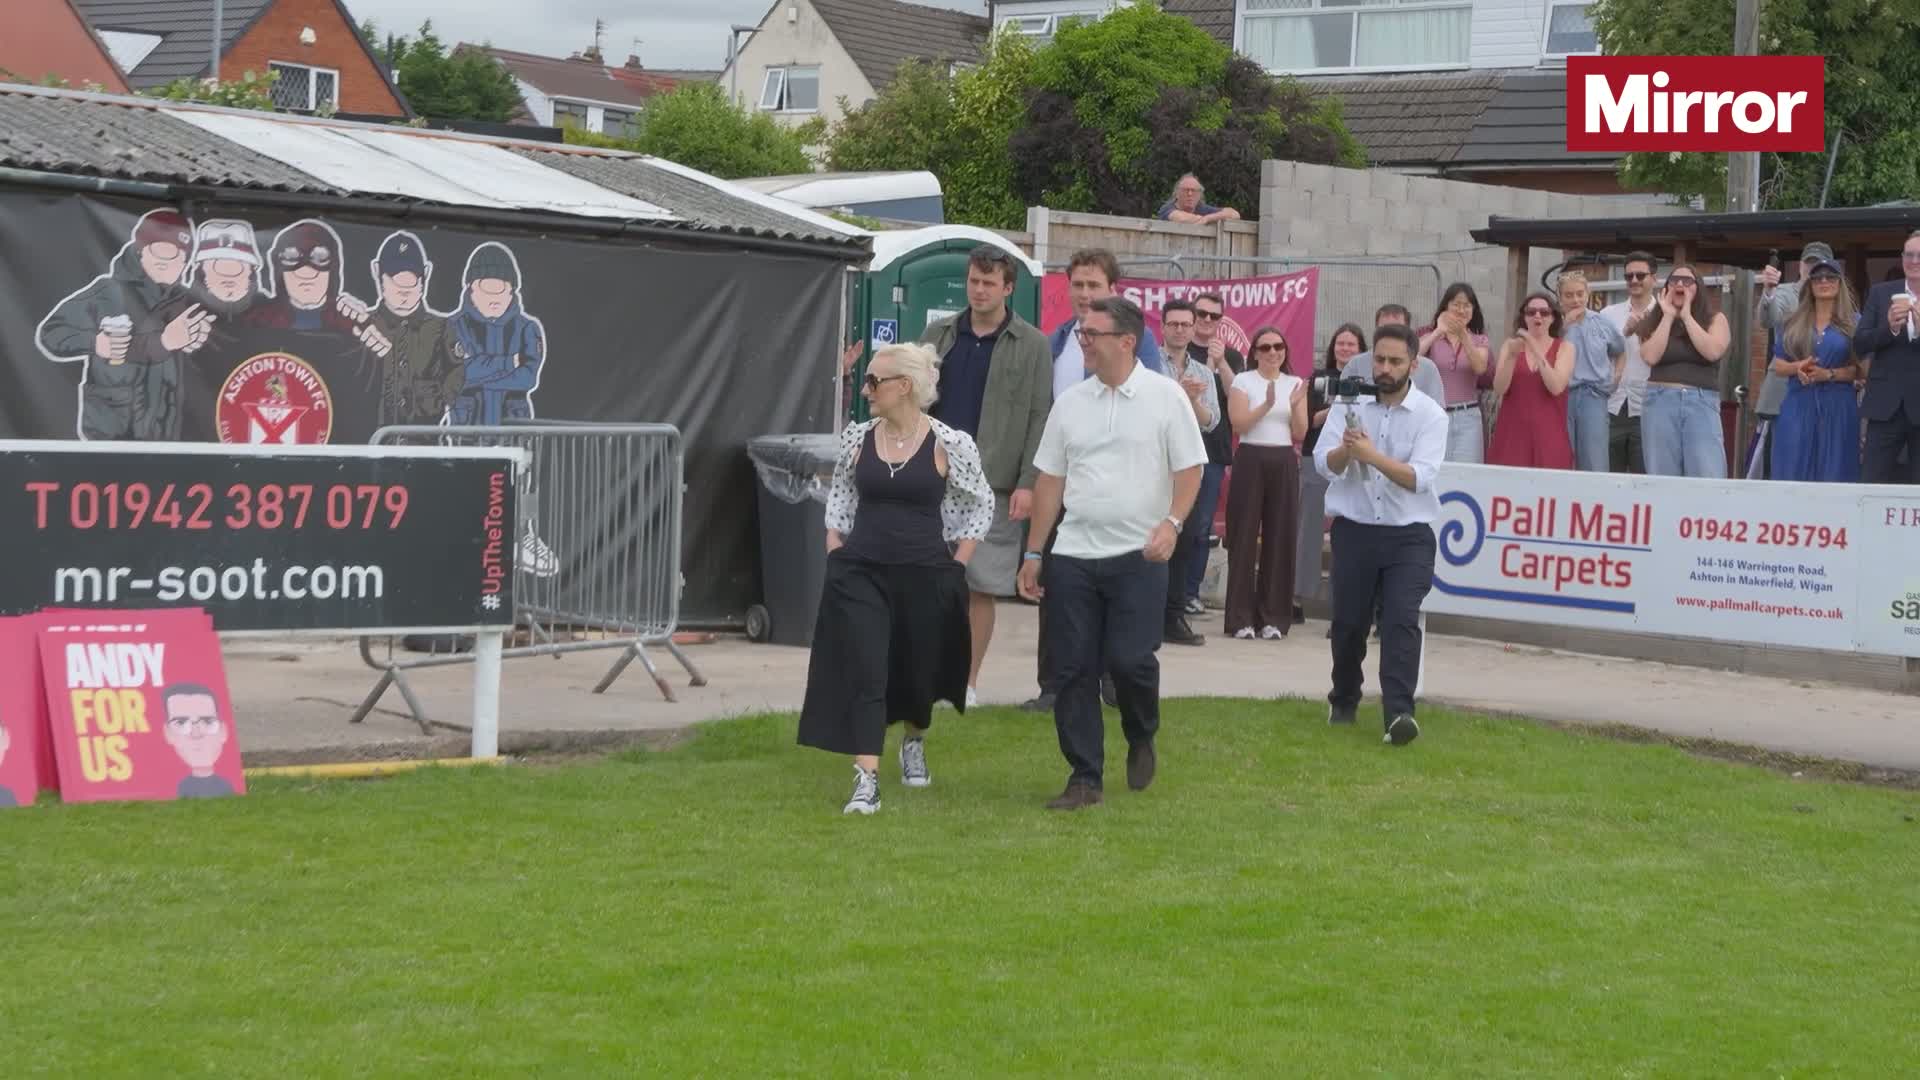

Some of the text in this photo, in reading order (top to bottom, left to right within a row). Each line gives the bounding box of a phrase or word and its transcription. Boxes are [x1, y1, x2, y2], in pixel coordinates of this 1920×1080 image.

[1219, 281, 1277, 308] TOWN
[1283, 276, 1309, 303] FC
[224, 358, 326, 410] ASHTON TOWN FC
[25, 482, 409, 529] T 01942 387 079
[1490, 496, 1652, 545] Pall Mall
[482, 472, 504, 610] #UpTheTown
[1679, 517, 1848, 549] 01942 205794
[54, 558, 383, 603] mr-soot.com
[1501, 543, 1632, 592] Carpets
[1690, 571, 1833, 595] Ashton in Makerfield, Wigan
[1697, 557, 1827, 577] 144-146 Warrington Road,
[1676, 596, 1843, 620] www.pallmallcarpets.co.uk
[1891, 600, 1920, 620] sa
[65, 643, 165, 689] ANDY
[70, 688, 151, 735] FOR
[78, 735, 133, 783] US
